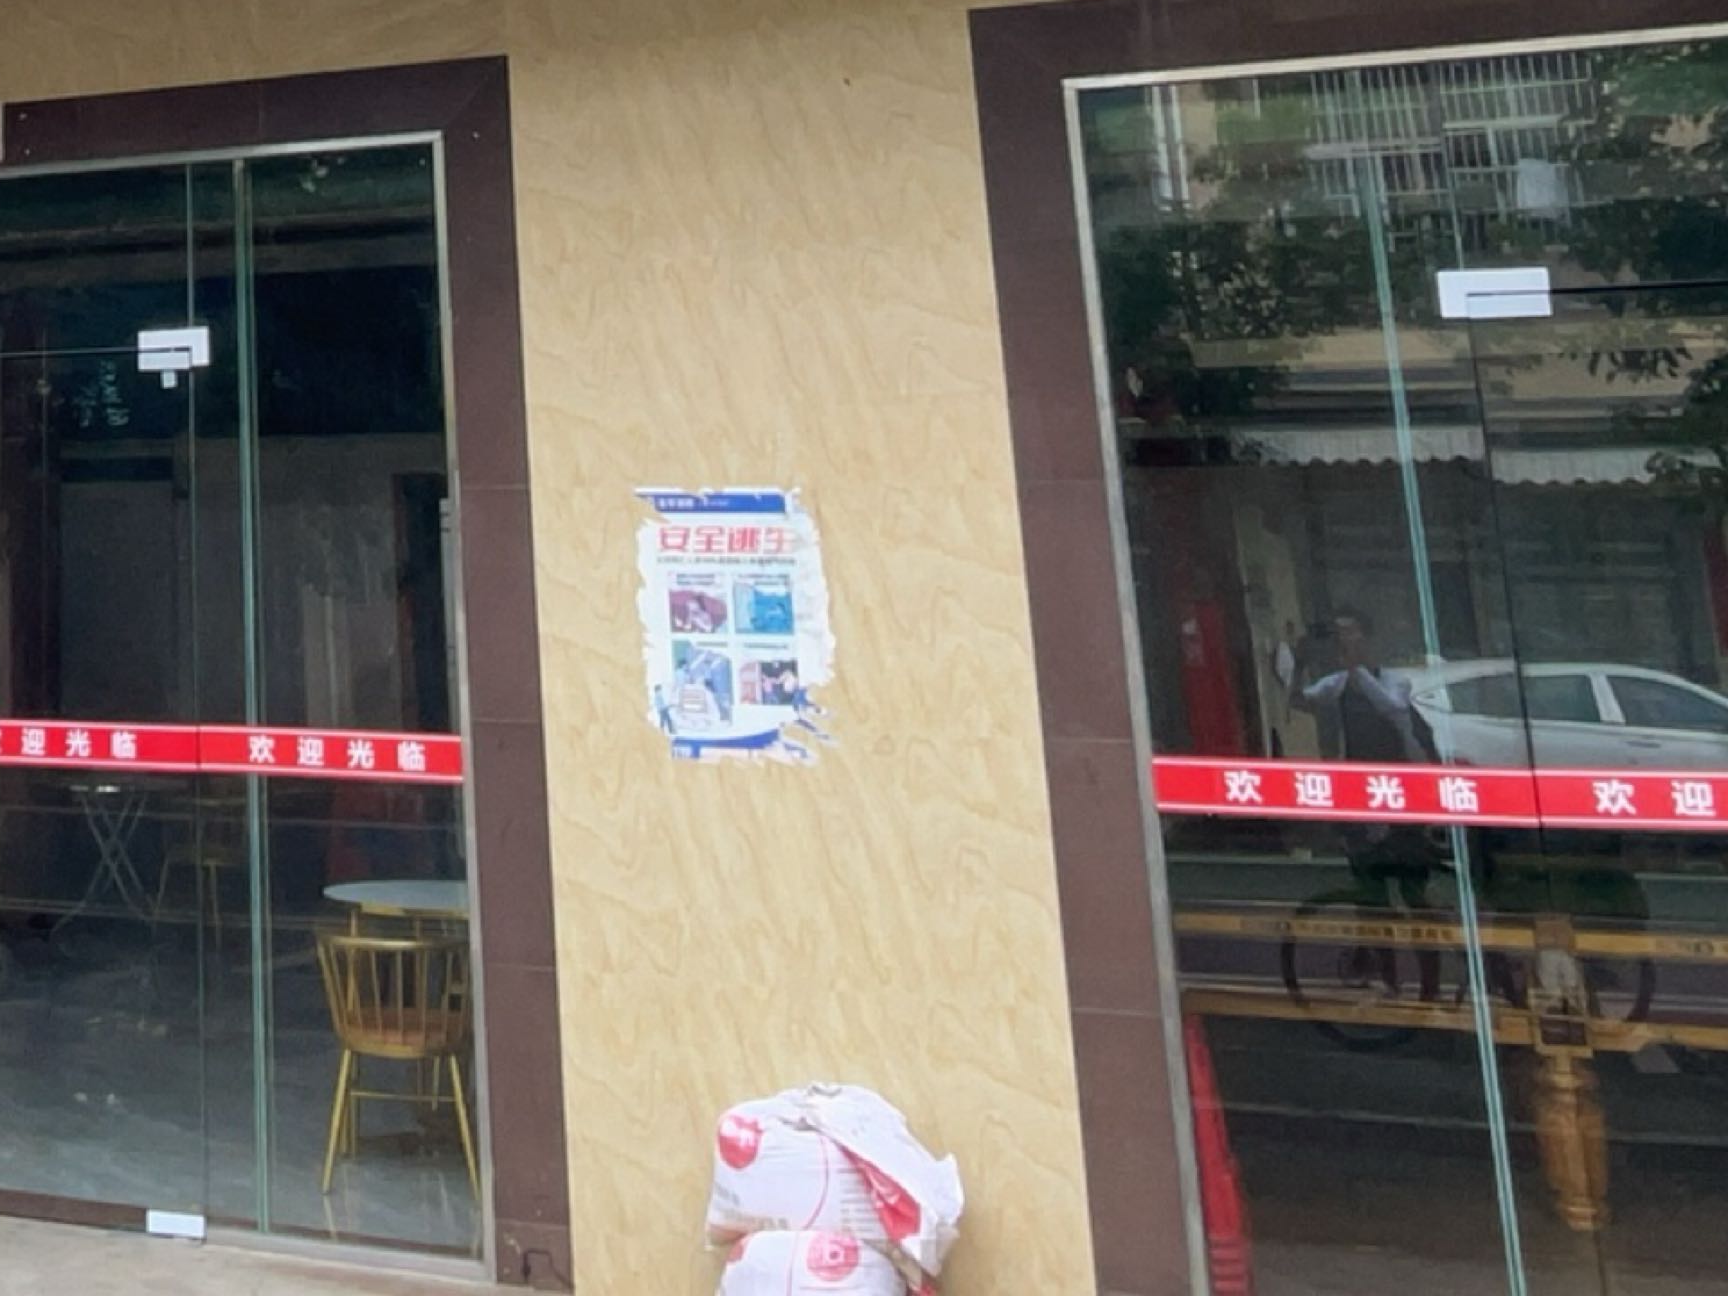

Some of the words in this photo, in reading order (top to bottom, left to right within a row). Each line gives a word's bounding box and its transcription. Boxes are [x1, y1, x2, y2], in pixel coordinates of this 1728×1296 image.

[248, 734, 427, 772] 欢迎光临
[1224, 769, 1480, 814] 欢迎光临
[1592, 779, 1716, 817] 欢迎
